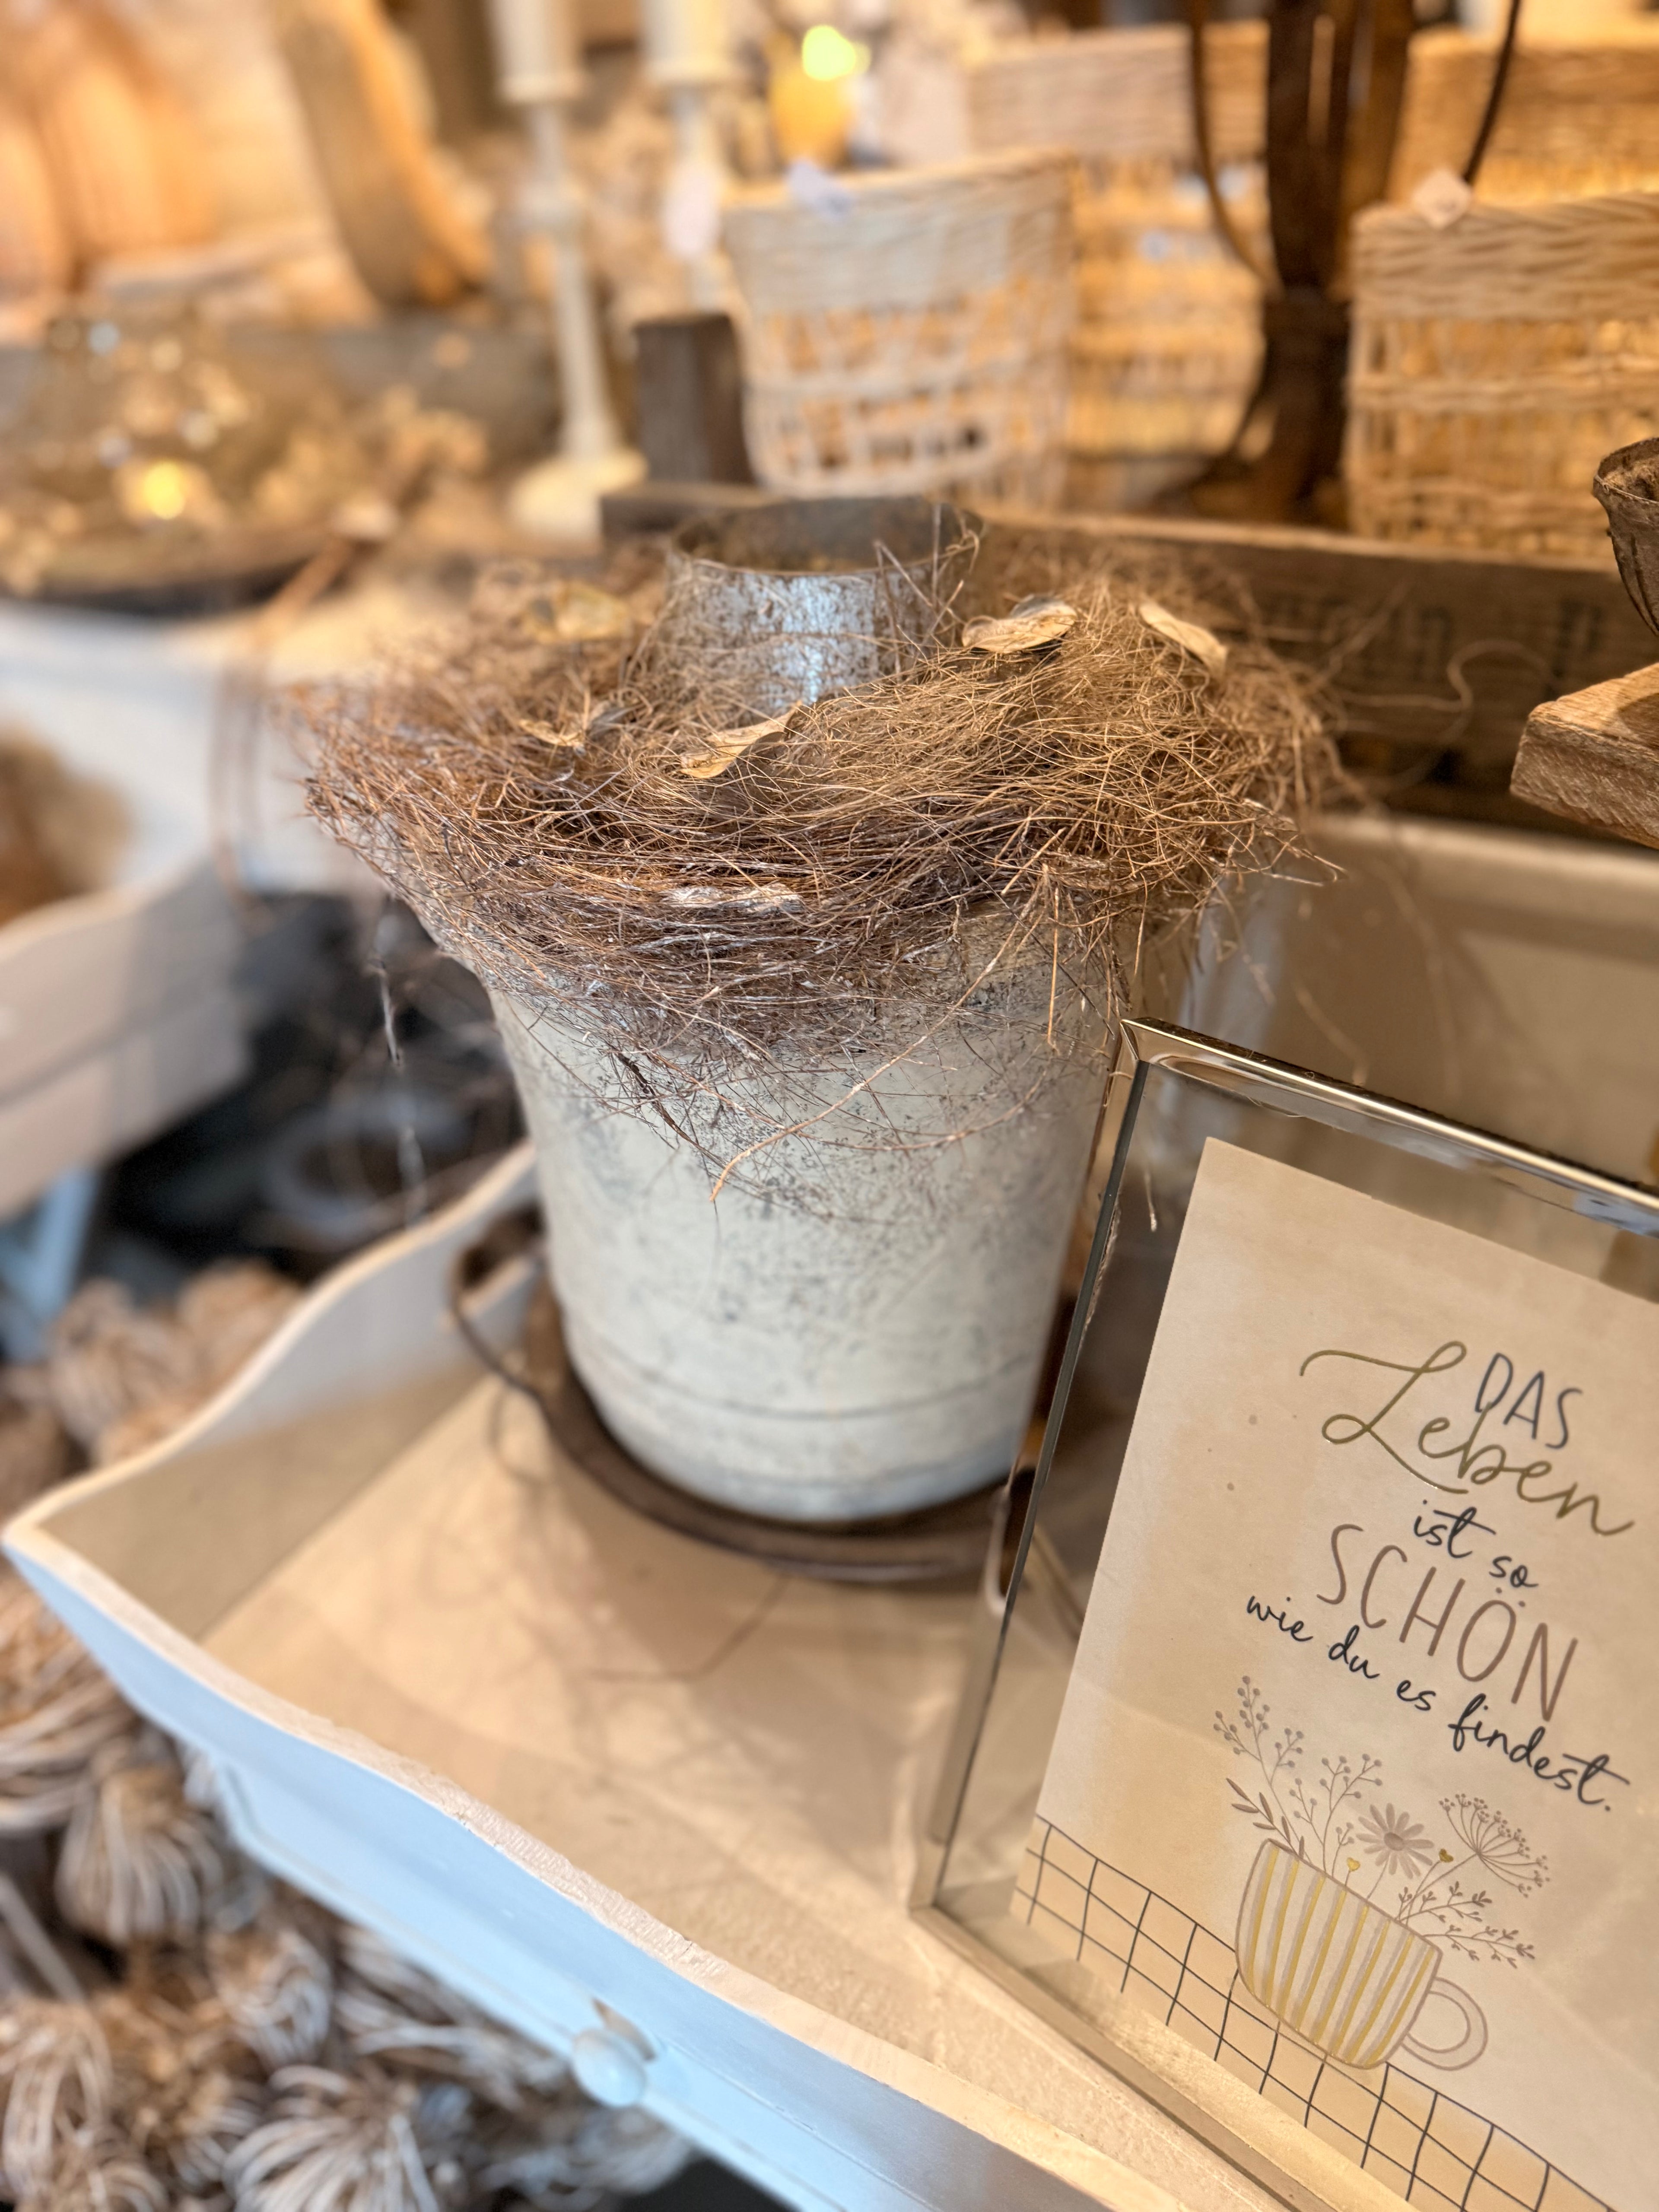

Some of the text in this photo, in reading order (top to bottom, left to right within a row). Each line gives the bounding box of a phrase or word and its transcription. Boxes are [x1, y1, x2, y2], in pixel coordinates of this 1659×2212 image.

[1299, 1340, 1635, 1536] Leben
[1474, 1351, 1583, 1449] DAS
[1317, 1523, 1579, 1722] SCHÖN
[1414, 1500, 1538, 1589] ist so
[1246, 1594, 1630, 1812] wie du es findest.
